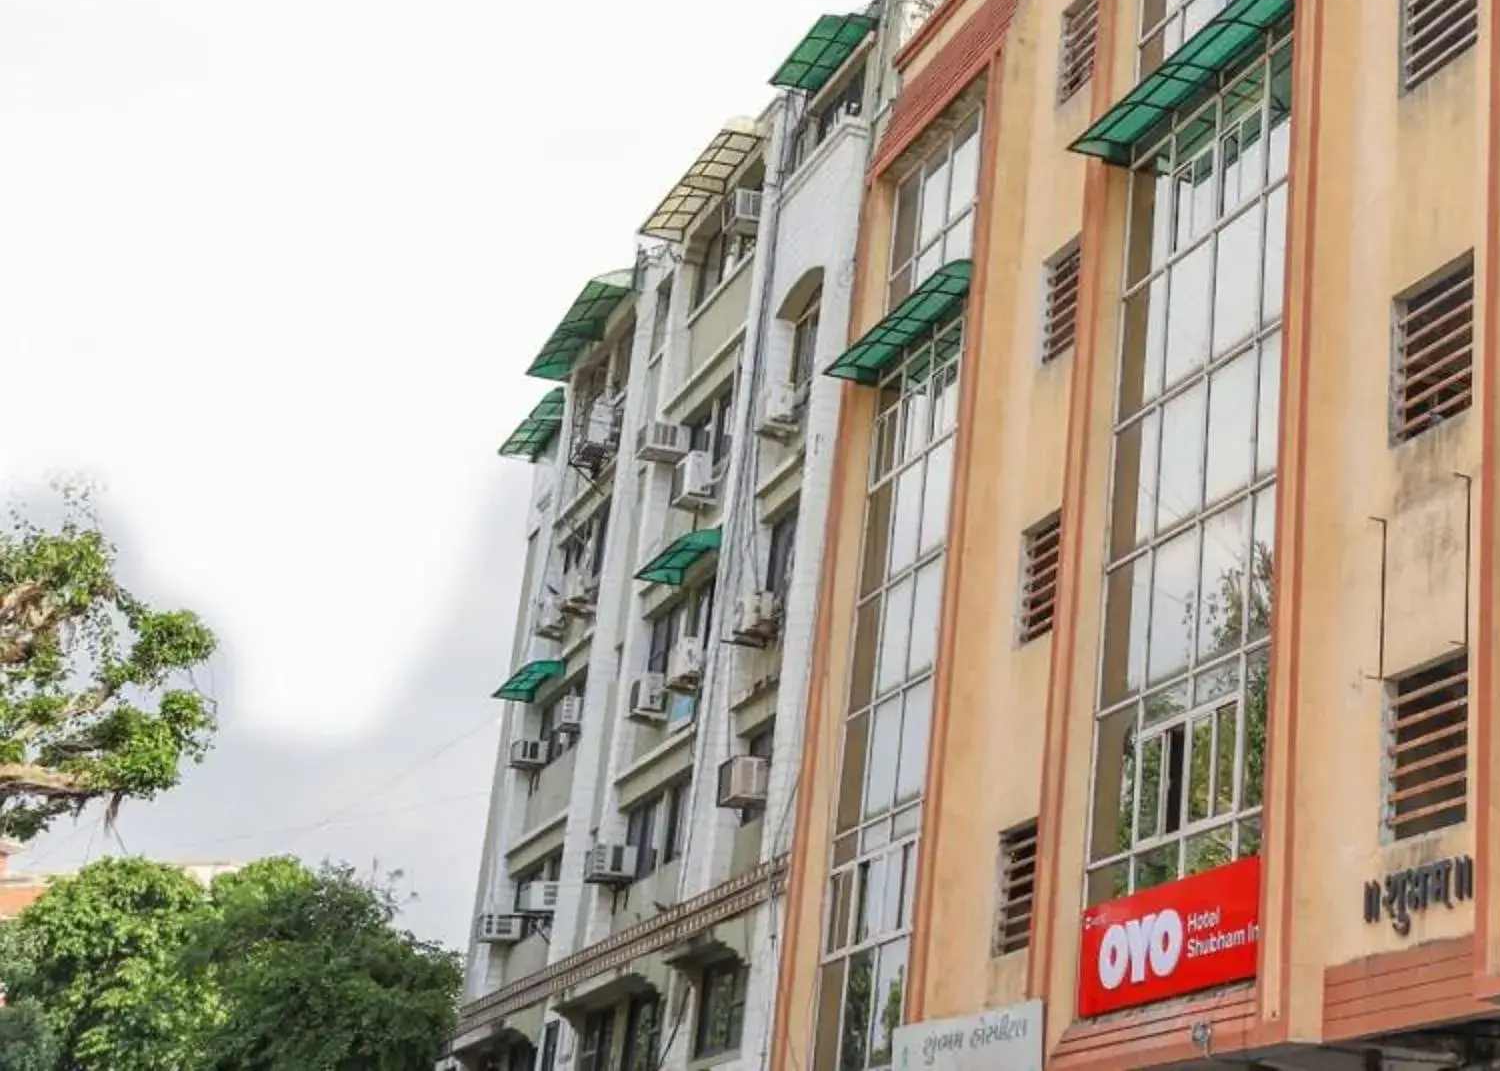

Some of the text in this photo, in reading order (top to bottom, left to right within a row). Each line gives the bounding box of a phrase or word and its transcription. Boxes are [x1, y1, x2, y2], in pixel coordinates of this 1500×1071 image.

[1187, 905, 1221, 933] Hotel
[1098, 908, 1184, 990] OYO
[1186, 927, 1246, 959] Shubham
